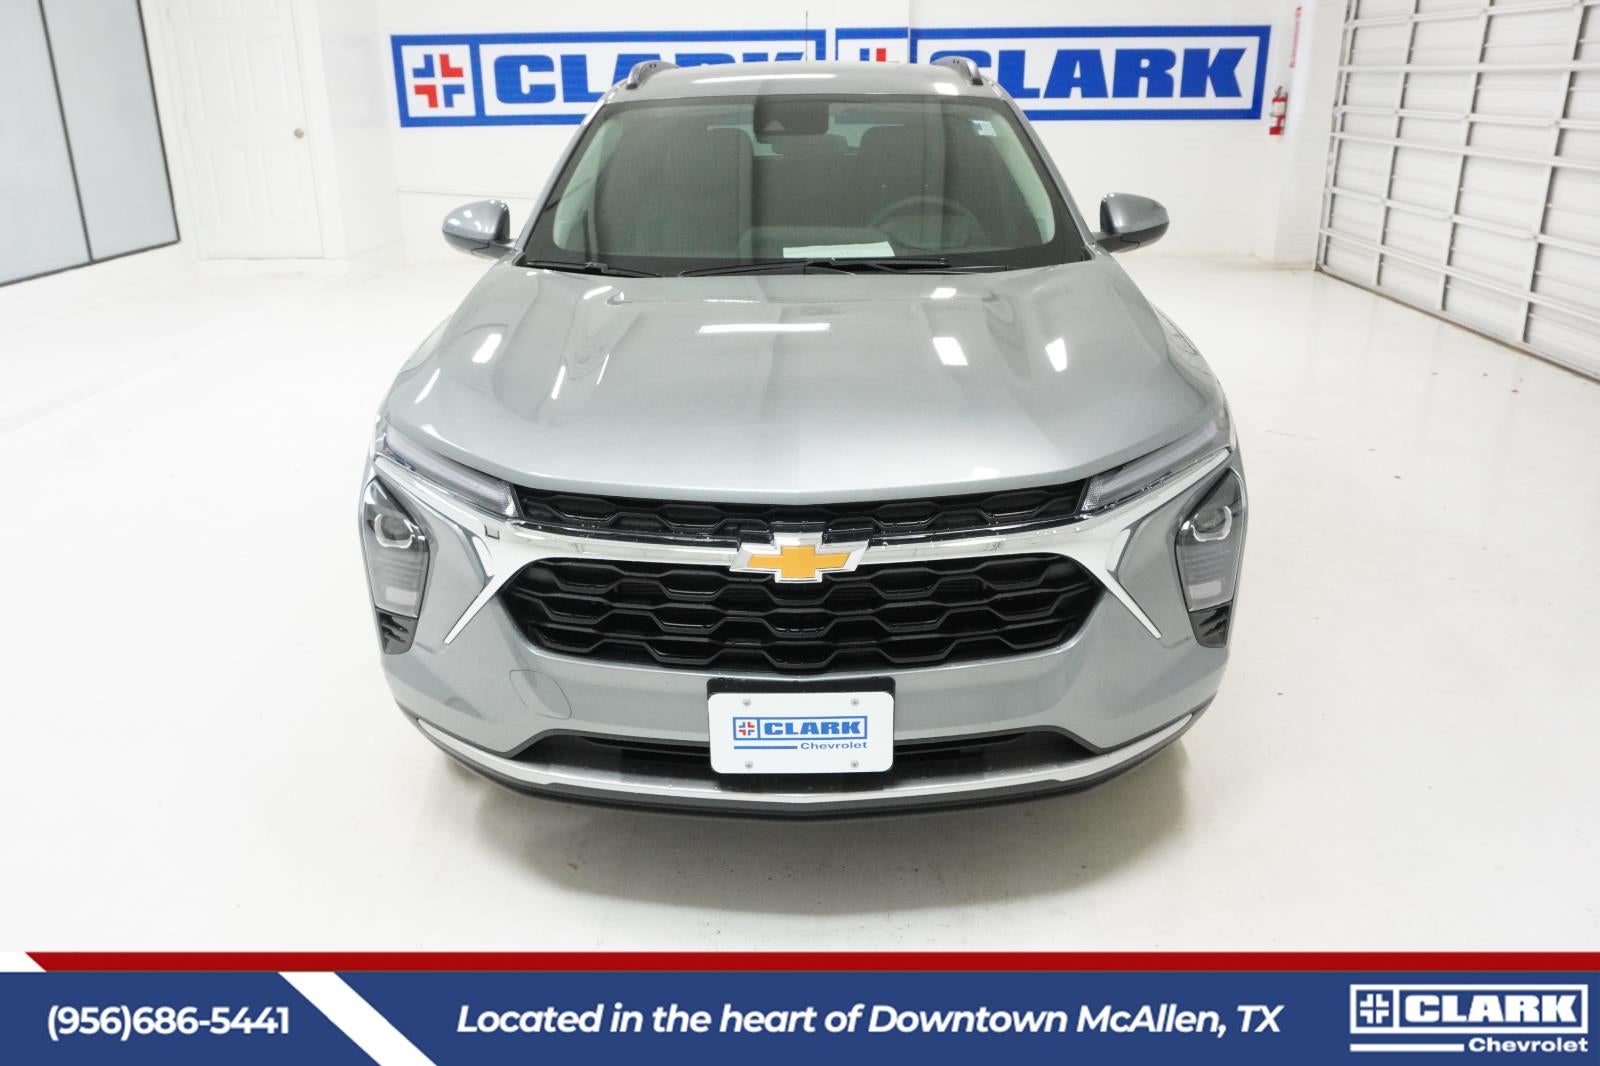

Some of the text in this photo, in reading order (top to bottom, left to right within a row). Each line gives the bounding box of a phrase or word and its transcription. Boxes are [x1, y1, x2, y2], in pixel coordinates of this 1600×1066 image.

[930, 48, 1247, 100] LARK
[764, 720, 861, 736] CLARK
[800, 740, 868, 750] Chevrolet
